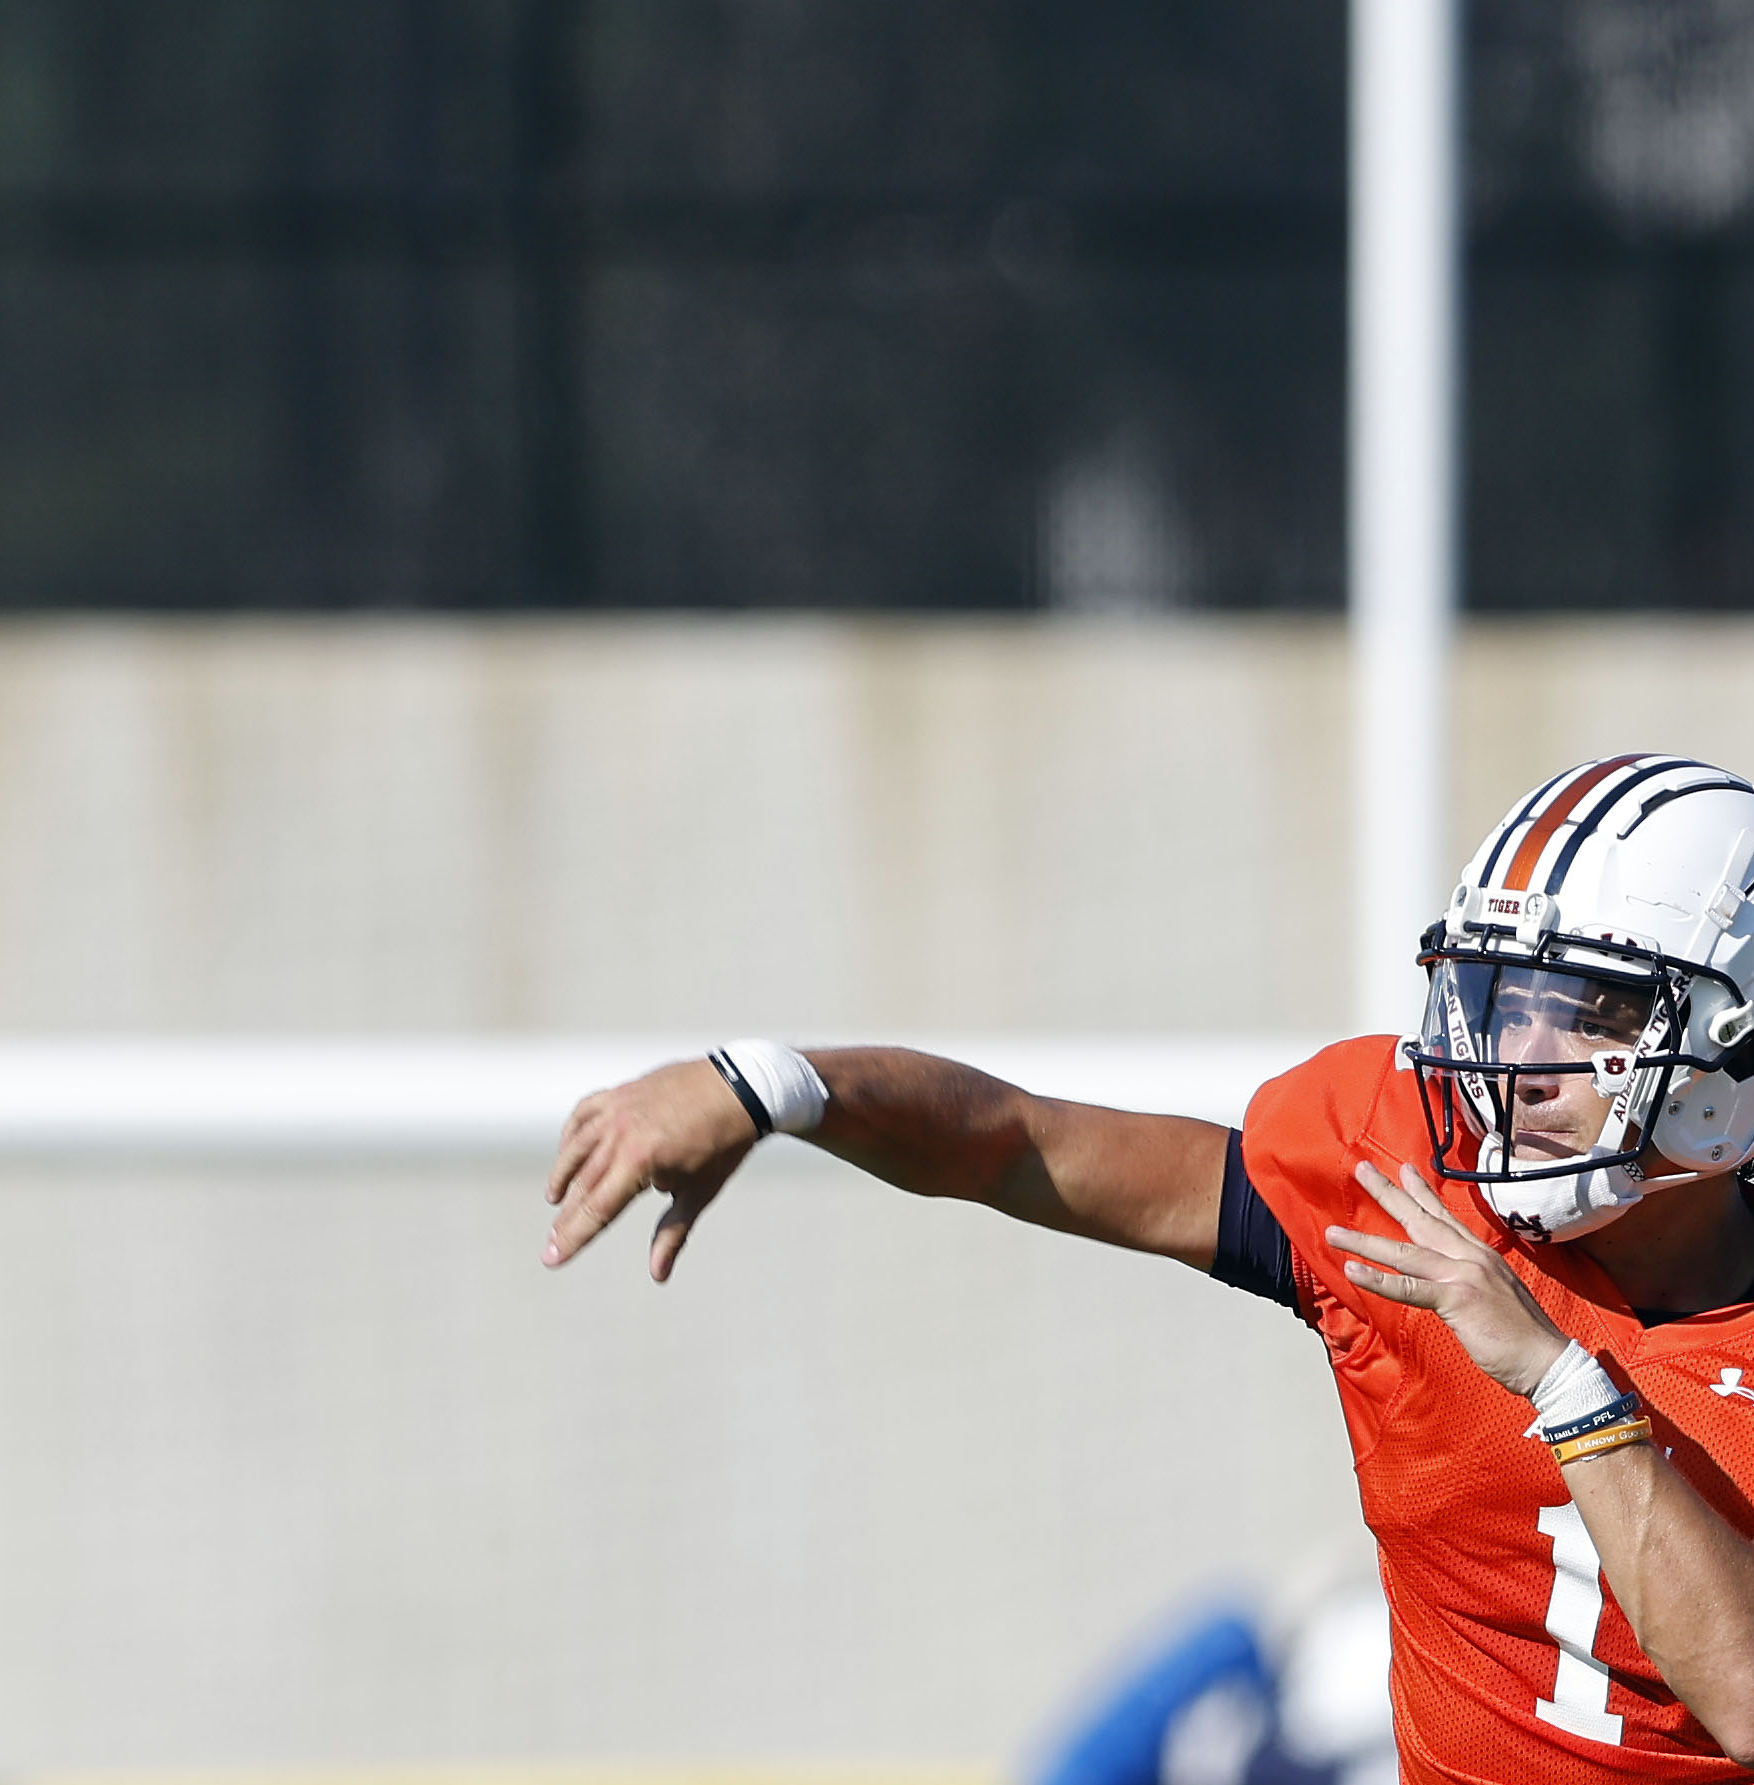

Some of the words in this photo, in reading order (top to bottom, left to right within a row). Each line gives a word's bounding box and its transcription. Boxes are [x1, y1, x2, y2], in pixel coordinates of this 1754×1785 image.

[1451, 1019, 1485, 1099] TIGRS
[1584, 1434, 1616, 1449] KNOW
[1536, 1500, 1624, 1747] 1
